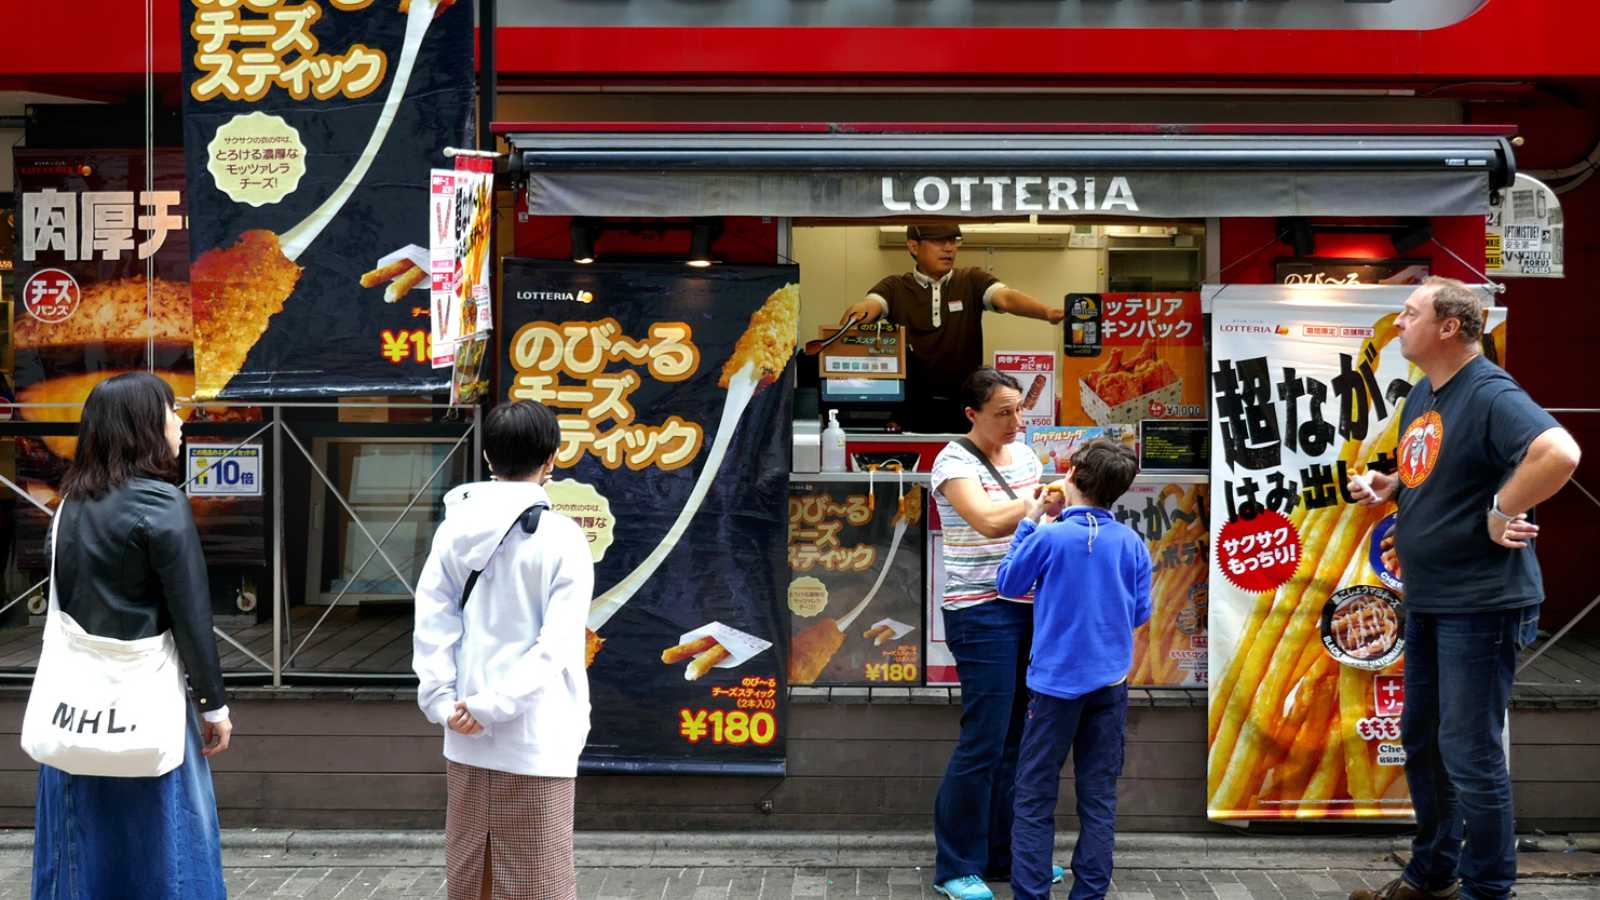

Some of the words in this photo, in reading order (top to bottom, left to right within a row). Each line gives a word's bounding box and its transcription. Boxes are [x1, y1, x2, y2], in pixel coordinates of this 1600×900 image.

[194, 5, 318, 53] チーズ
[195, 47, 384, 97] スティック
[215, 147, 300, 161] とろける濃厚な
[225, 162, 291, 176] モッツァレラ
[239, 177, 279, 190] チーズ!
[880, 175, 1140, 213] LOTTERIA
[22, 188, 190, 262] 肉厚チ
[31, 280, 73, 304] チーズ
[516, 290, 574, 301] LOTTERIA
[1101, 297, 1183, 317] ッテリア
[1219, 324, 1271, 334] LOTTERIA
[1222, 526, 1289, 557] サクサク
[865, 662, 918, 682] ¥180
[711, 687, 776, 698] チーズスティック
[52, 701, 137, 734] MHL.
[679, 708, 776, 745] ¥180
